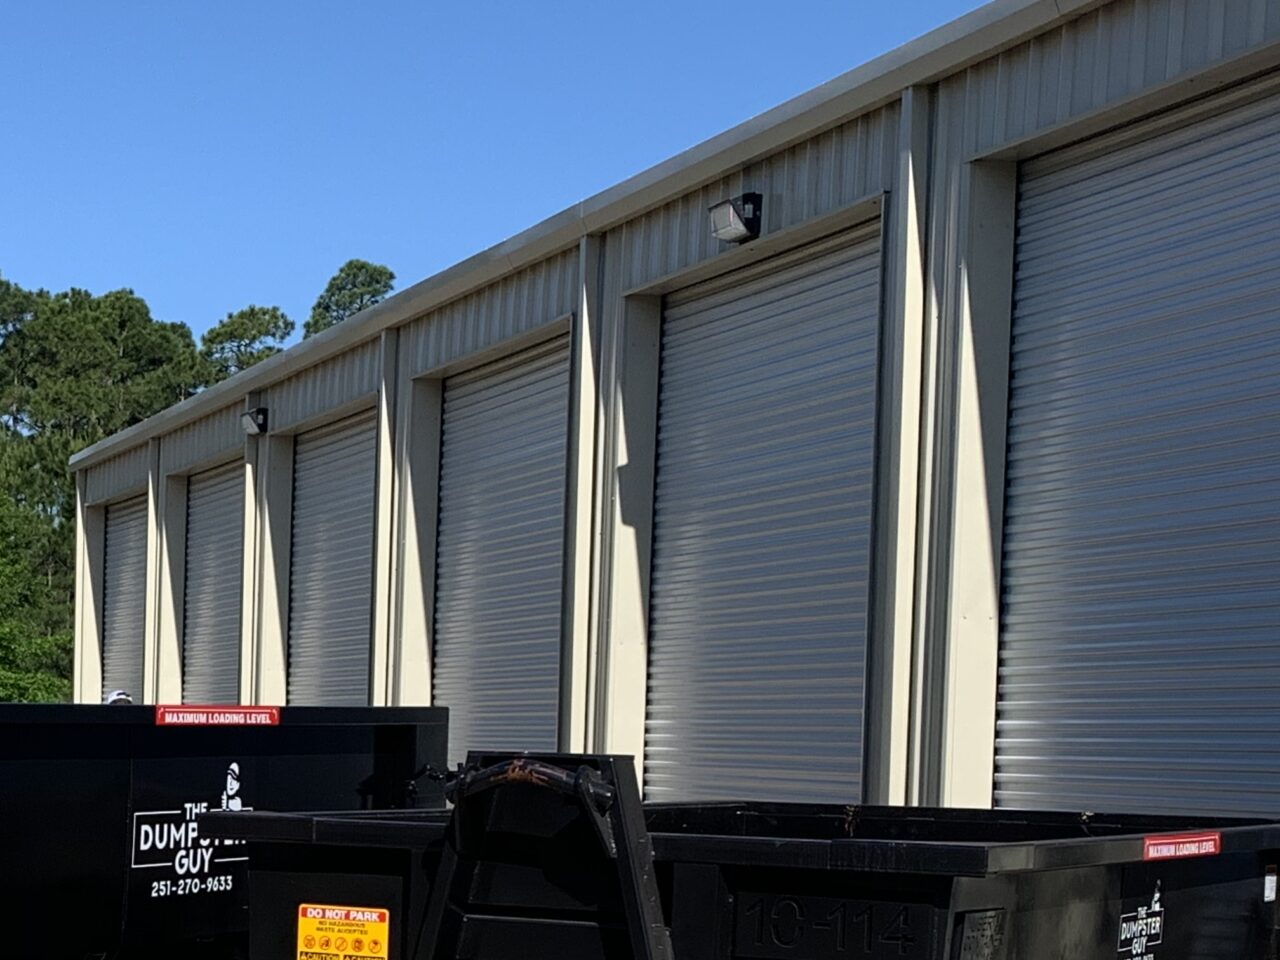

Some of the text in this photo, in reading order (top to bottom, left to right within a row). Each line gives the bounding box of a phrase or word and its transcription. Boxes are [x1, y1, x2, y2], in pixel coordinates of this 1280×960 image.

[164, 713, 272, 724] MAXIMUM LOADING LEVEL
[184, 802, 208, 820] THE
[174, 847, 213, 875] GUY
[151, 875, 233, 897] 251-270-9633
[307, 908, 380, 921] DO NOT PARK
[745, 896, 915, 955] 10-114
[1121, 917, 1161, 940] DUMPSTER
[1132, 936, 1148, 955] GUY
